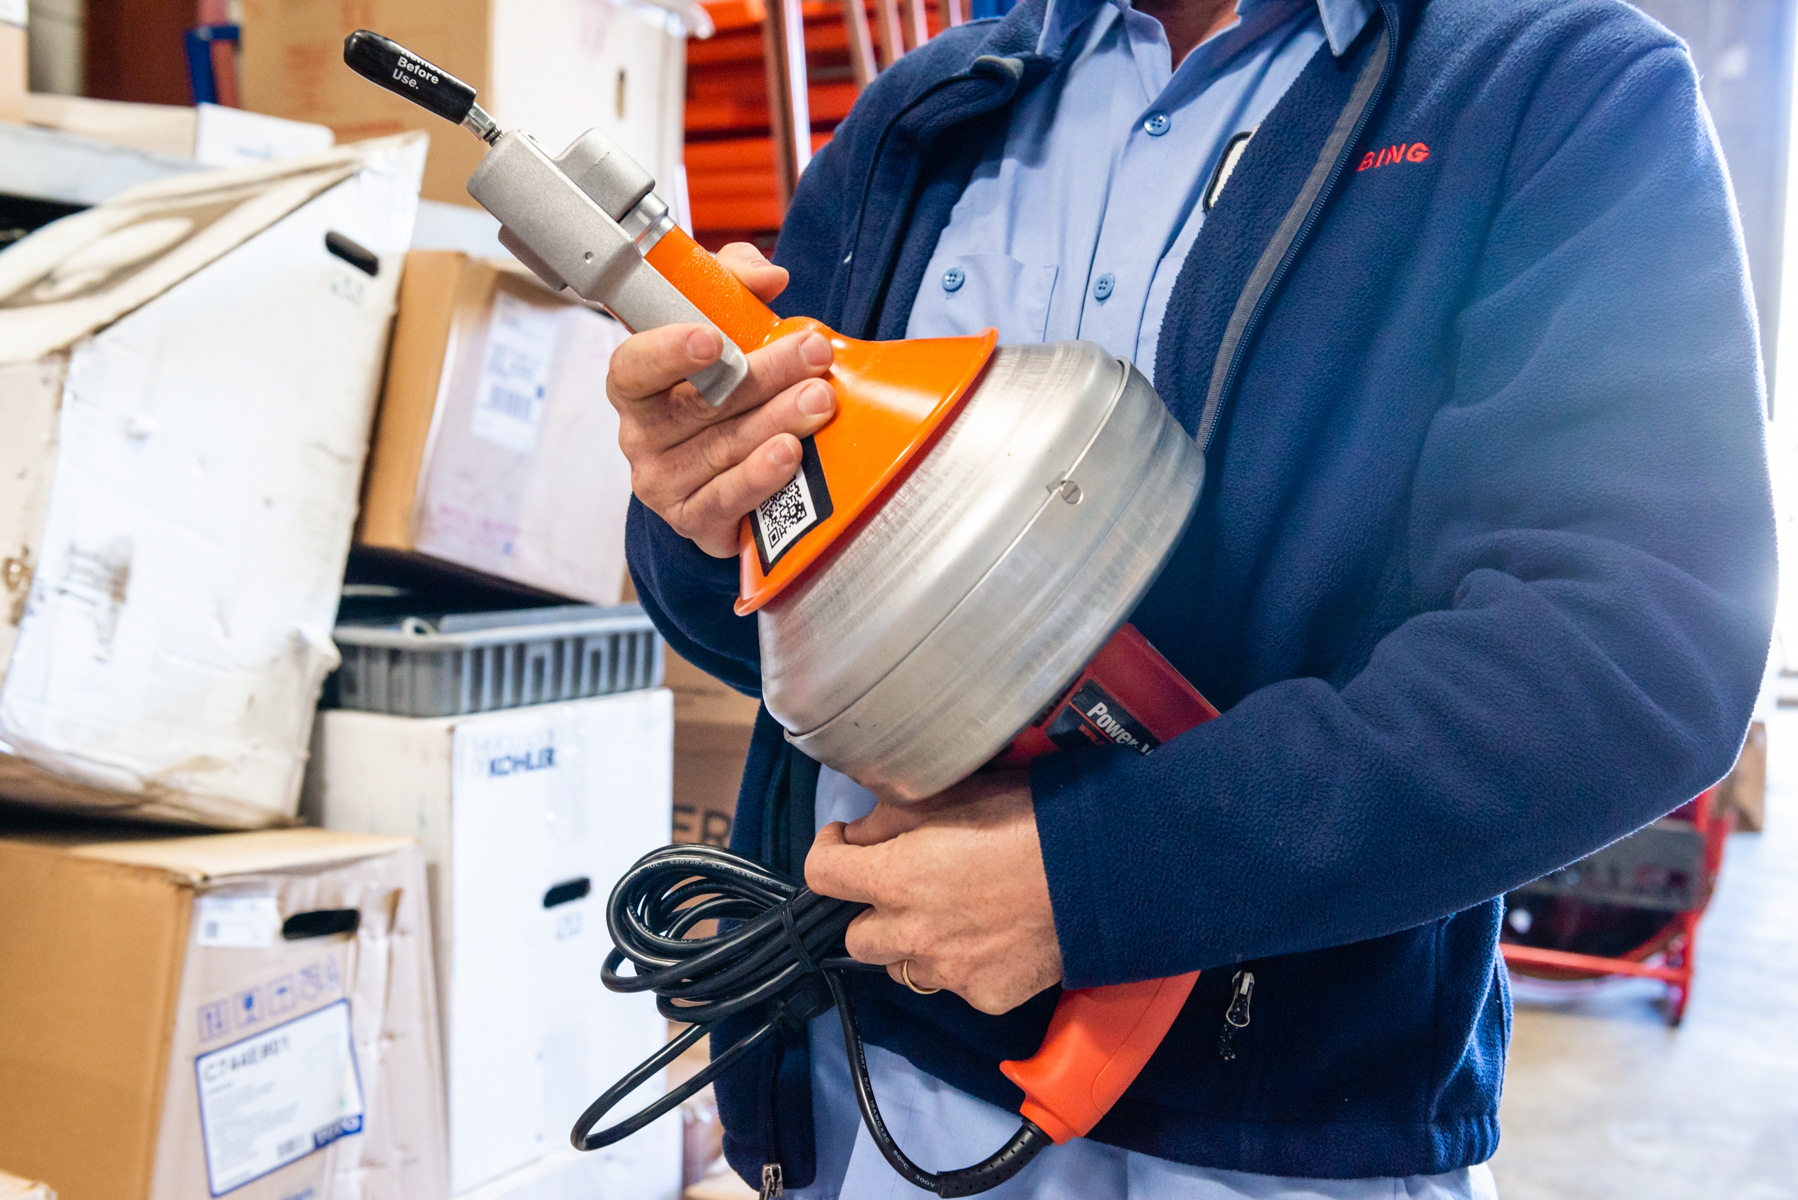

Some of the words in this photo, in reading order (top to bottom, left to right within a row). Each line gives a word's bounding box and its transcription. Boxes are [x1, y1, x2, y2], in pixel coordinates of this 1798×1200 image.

[392, 68, 419, 90] Use.
[397, 55, 439, 85] Before
[914, 1173, 936, 1188] 300V
